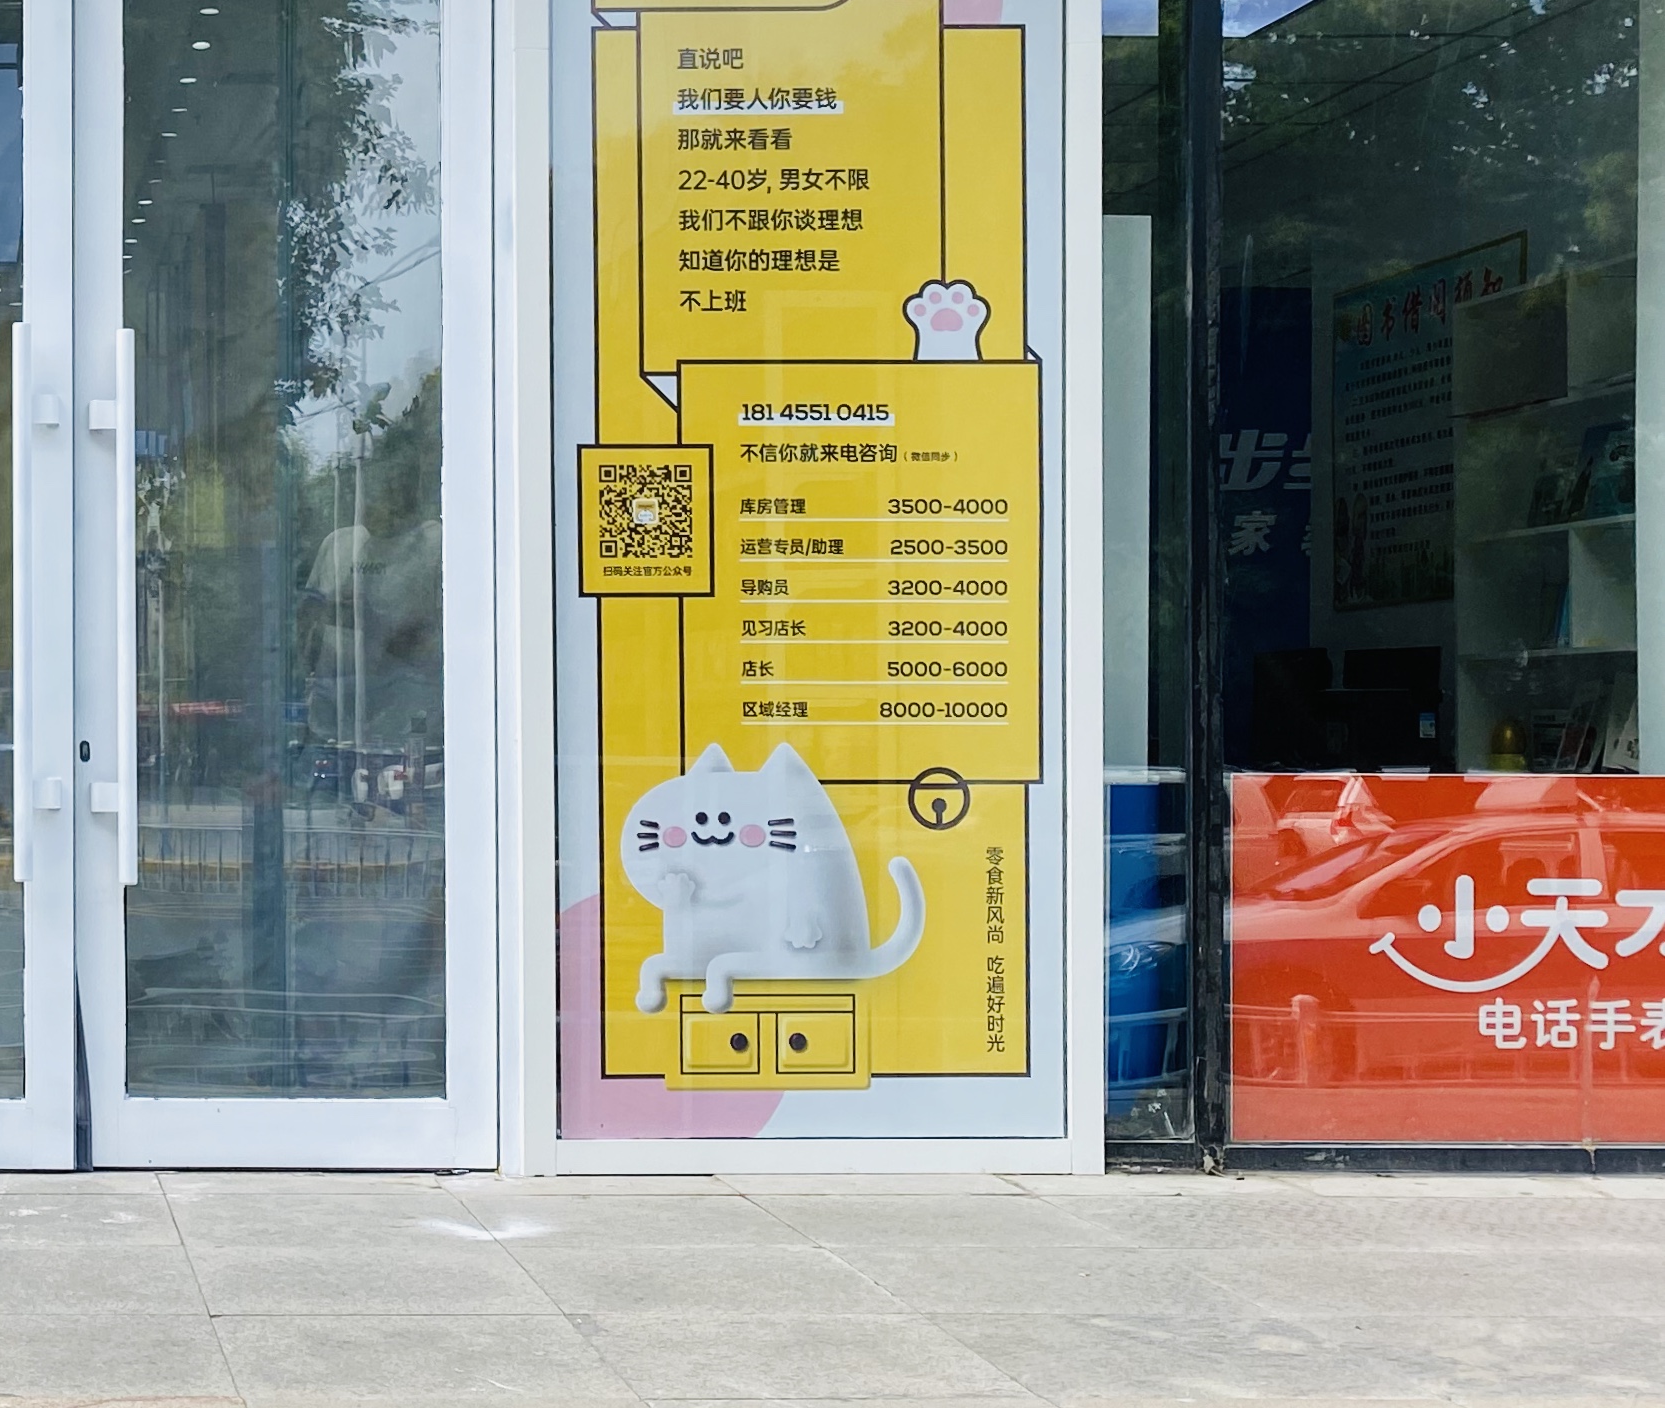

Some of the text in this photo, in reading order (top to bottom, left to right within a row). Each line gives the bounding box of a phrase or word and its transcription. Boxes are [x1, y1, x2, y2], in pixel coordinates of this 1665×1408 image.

[677, 48, 744, 70] 直说吧
[677, 88, 837, 111] 我们要人你要钱
[677, 129, 792, 151] 那就来看看
[679, 209, 864, 232] 我们不跟你谈理想
[679, 250, 840, 273] 知道你的理想是
[679, 290, 747, 313] 不上班
[742, 403, 890, 421] 181 4551 0415
[740, 443, 898, 463] 不信你就来电咨询
[740, 499, 1008, 515] 库房管理 3500-4000
[740, 539, 1008, 557] 运营专员/助理 2500-3500
[603, 566, 692, 577] 扫码关注官方公众号
[740, 579, 1008, 596] 导购员 3200-4000
[741, 620, 1008, 637] 见习店长 3200-4000
[741, 661, 1008, 678] 店长 5000-6000
[742, 702, 1008, 719] 区域经理 8000-10000
[985, 846, 1005, 1052] 零食新风尚 吃遍好时光
